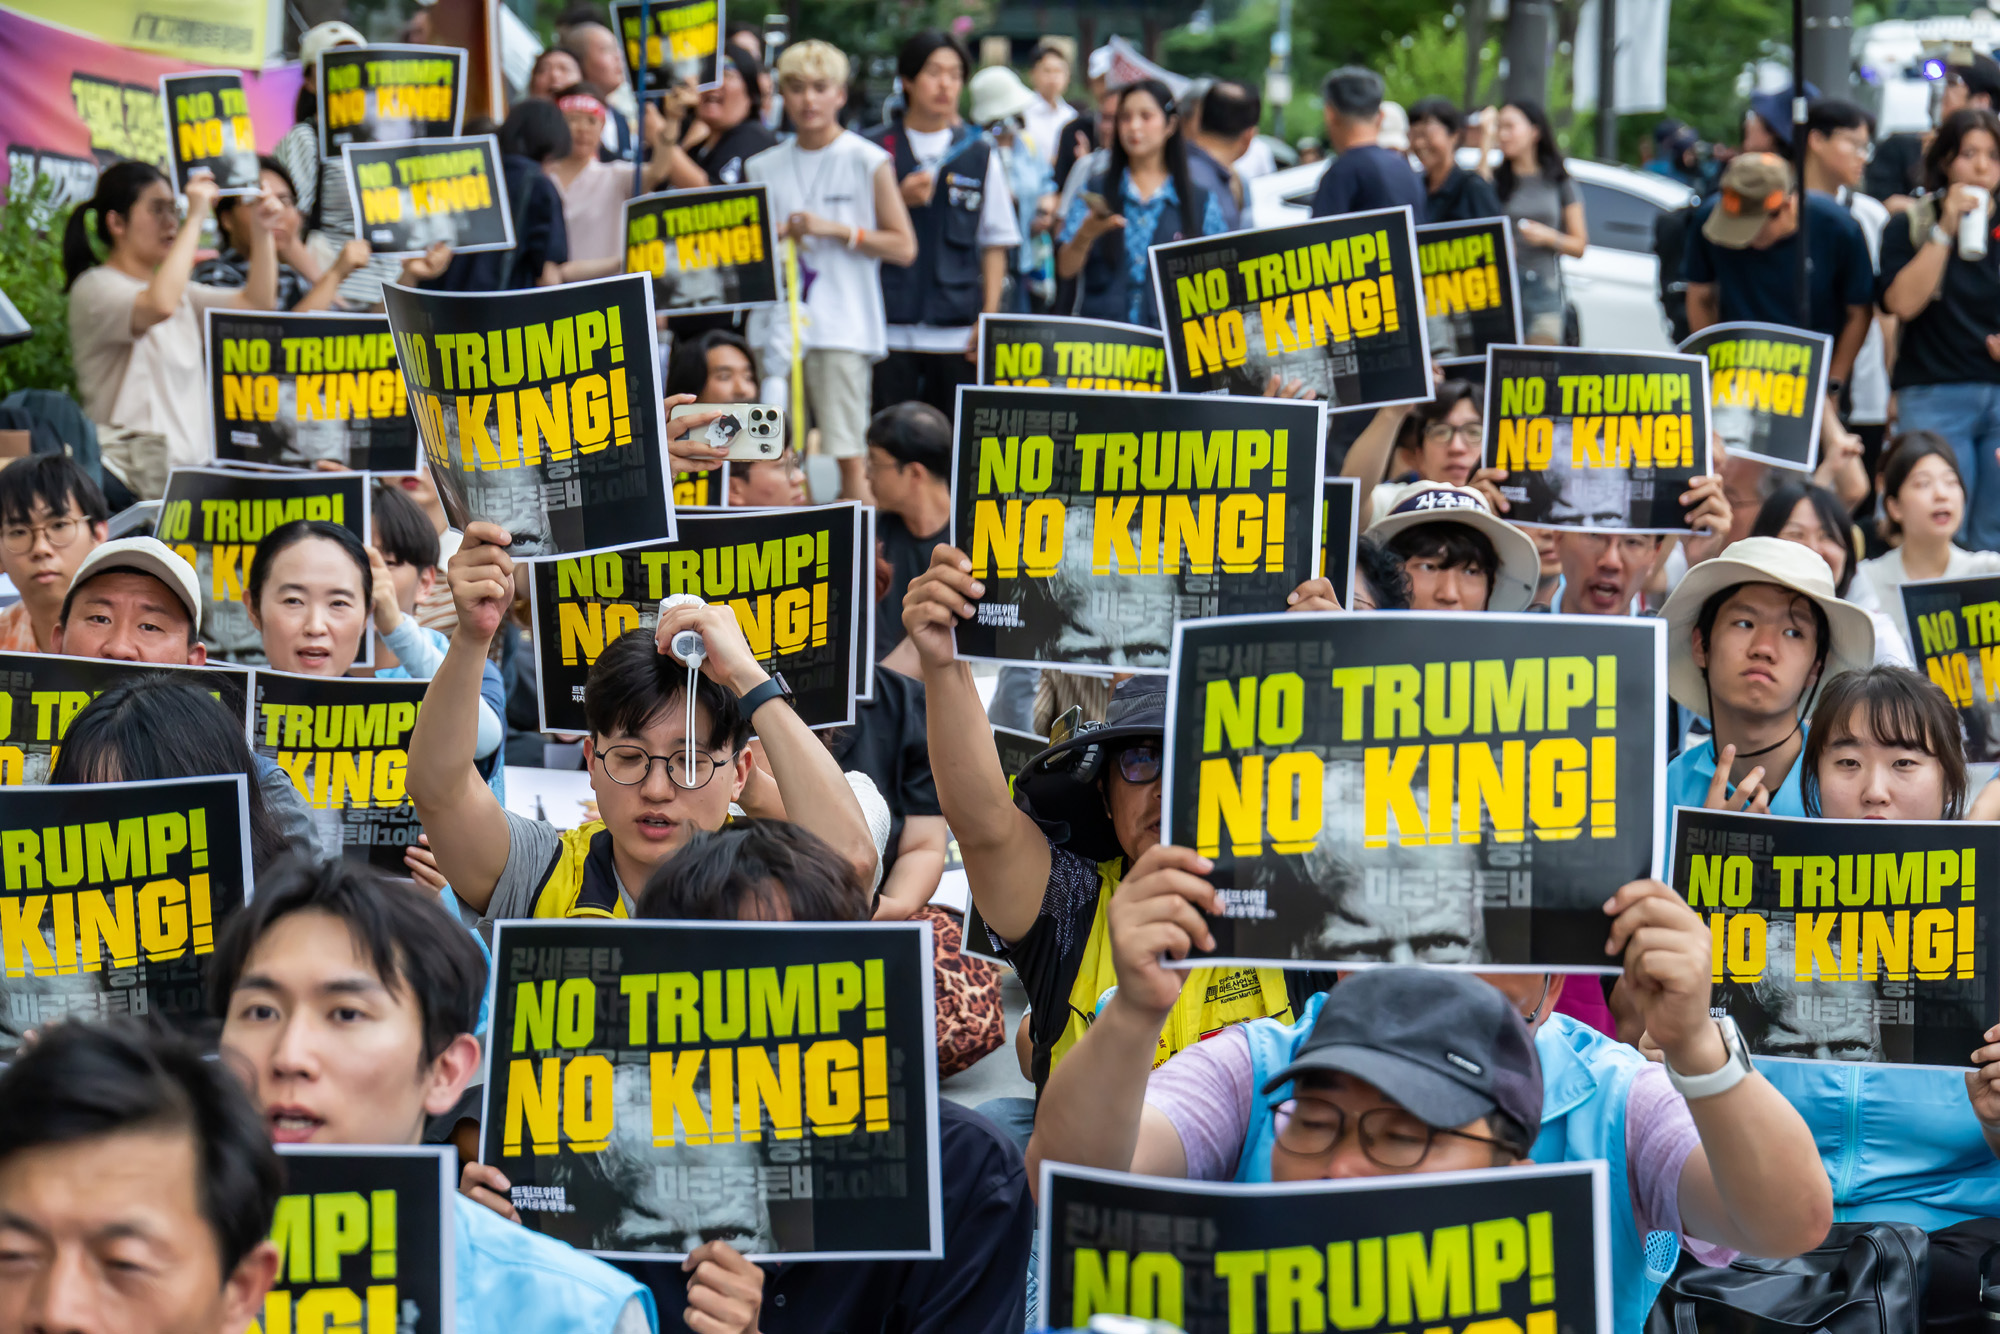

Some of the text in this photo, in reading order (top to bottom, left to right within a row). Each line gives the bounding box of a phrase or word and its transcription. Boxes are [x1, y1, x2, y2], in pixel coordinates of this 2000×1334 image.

[329, 60, 453, 93] NO TRUMP!
[329, 84, 452, 125] NO KING!
[176, 92, 215, 123] NO
[178, 118, 222, 161] NO
[356, 148, 486, 187] NO TRUMP!
[363, 173, 490, 223] NO KING!
[663, 196, 759, 238] TRUMP!
[676, 224, 763, 270] KING!
[1177, 268, 1229, 319] NO
[1238, 230, 1392, 301] TRUMP!
[223, 333, 396, 373] NO TRUMP
[399, 305, 624, 389] NO TRUMP!
[1183, 310, 1247, 377] NO
[1260, 275, 1399, 356] KING!
[995, 342, 1165, 383] NO TRUMP!
[1706, 338, 1813, 376] TRUMP!
[223, 369, 407, 421] NO KING!
[412, 390, 450, 470] NO
[456, 368, 632, 471] KING!
[1501, 374, 1690, 416] NO TRUMP!
[1711, 367, 1808, 418] KING!
[978, 429, 1288, 494] NO TRUMP!
[1496, 414, 1693, 471] NO KING!
[557, 530, 829, 599] NO TRUMP!
[971, 498, 1065, 579] NO
[1093, 493, 1285, 575] KING!
[1918, 610, 1957, 654] NO
[1203, 656, 1616, 753] NO TRUMP!
[1926, 652, 1974, 709] NO
[261, 701, 422, 748] TRUMP
[1197, 737, 1616, 859] NO KING!
[2, 808, 208, 890] RUMP!
[1688, 848, 1975, 907] NO TRUMP!
[0, 873, 214, 977] KING!
[1795, 907, 1974, 982] KING!
[512, 959, 885, 1052] NO TRUMP!
[504, 1036, 889, 1156] NO KING!
[1073, 1211, 1555, 1334] NO TRUMP!
